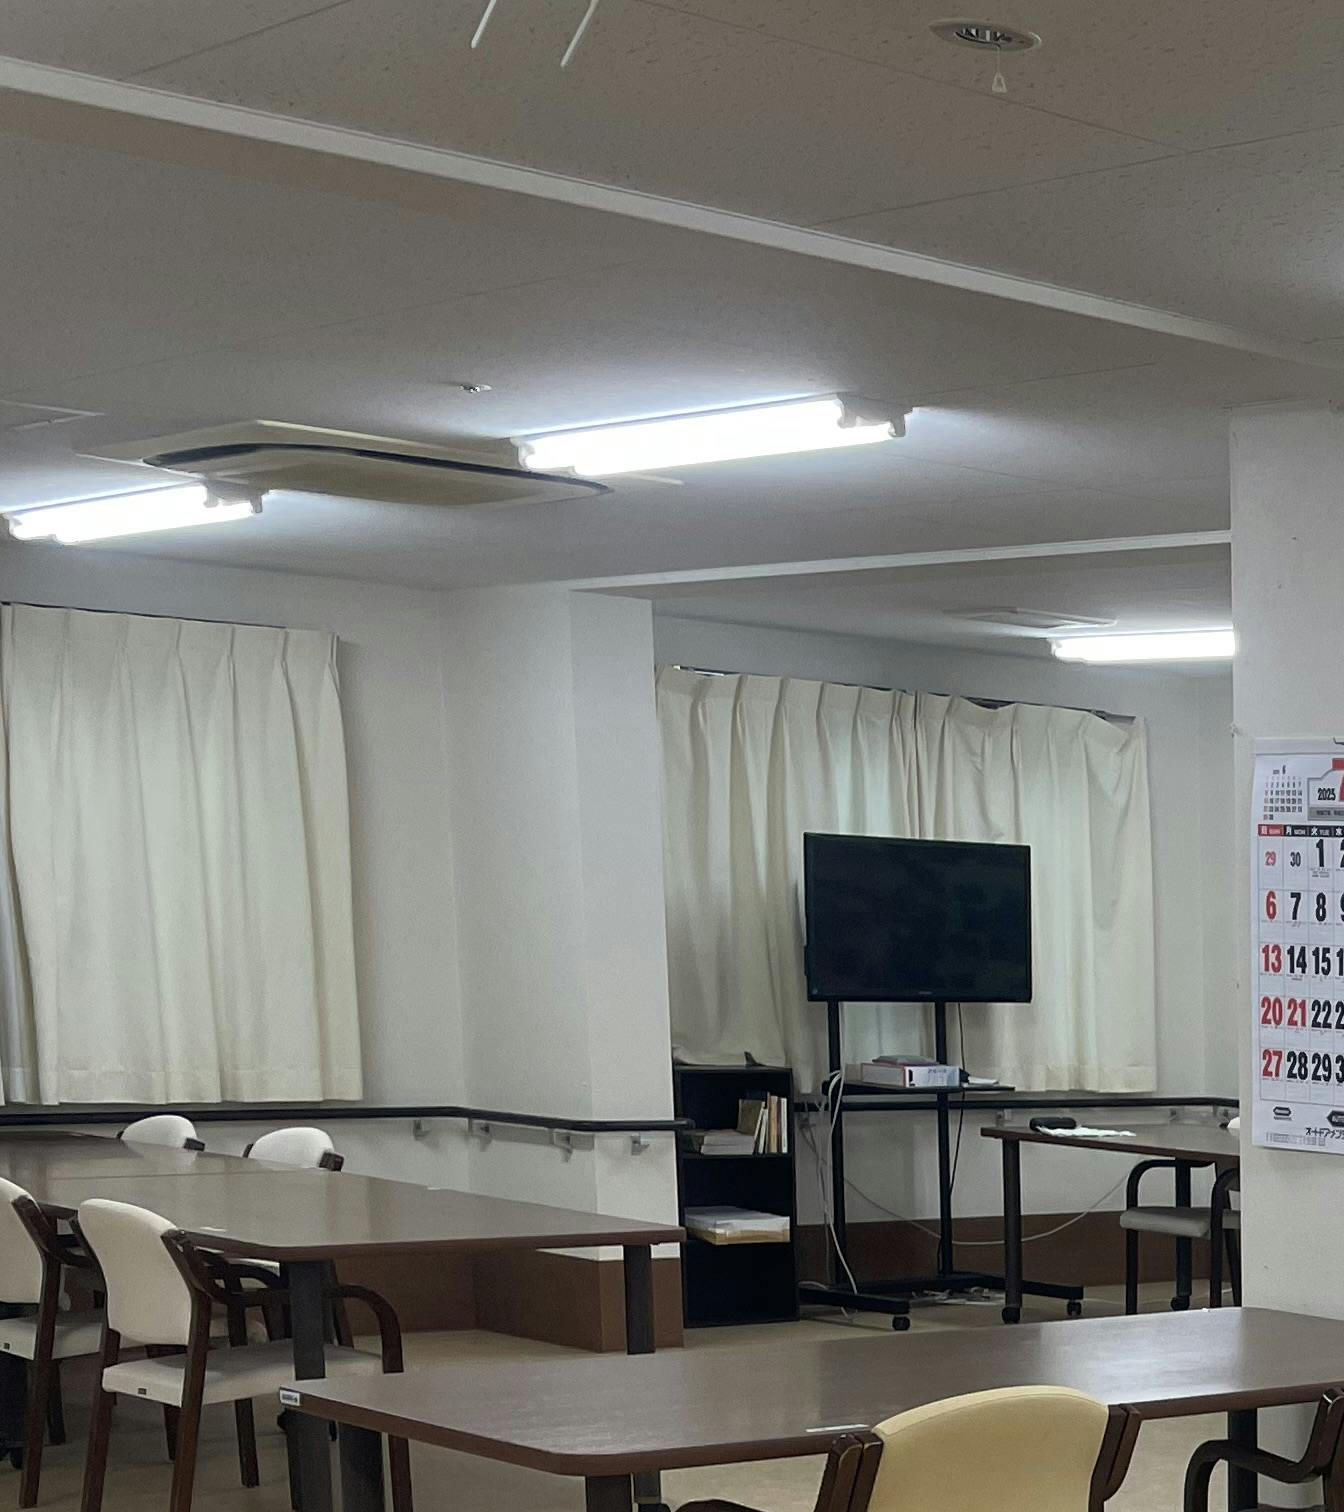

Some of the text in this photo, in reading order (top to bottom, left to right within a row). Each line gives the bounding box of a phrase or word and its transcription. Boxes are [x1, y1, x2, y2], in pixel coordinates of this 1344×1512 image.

[1290, 852, 1301, 867] 30
[1316, 839, 1324, 867] 1
[1266, 891, 1276, 919] 6
[1291, 892, 1301, 920] 7
[1316, 892, 1326, 921] 8
[1262, 944, 1282, 973] 13
[1287, 946, 1307, 974] 14
[1312, 947, 1331, 975] 15
[1261, 996, 1283, 1026] 20
[1287, 998, 1307, 1027] 21
[1311, 999, 1332, 1028] 22
[1262, 1049, 1282, 1077] 27
[1287, 1051, 1308, 1080] 28
[1311, 1053, 1332, 1082] 29
